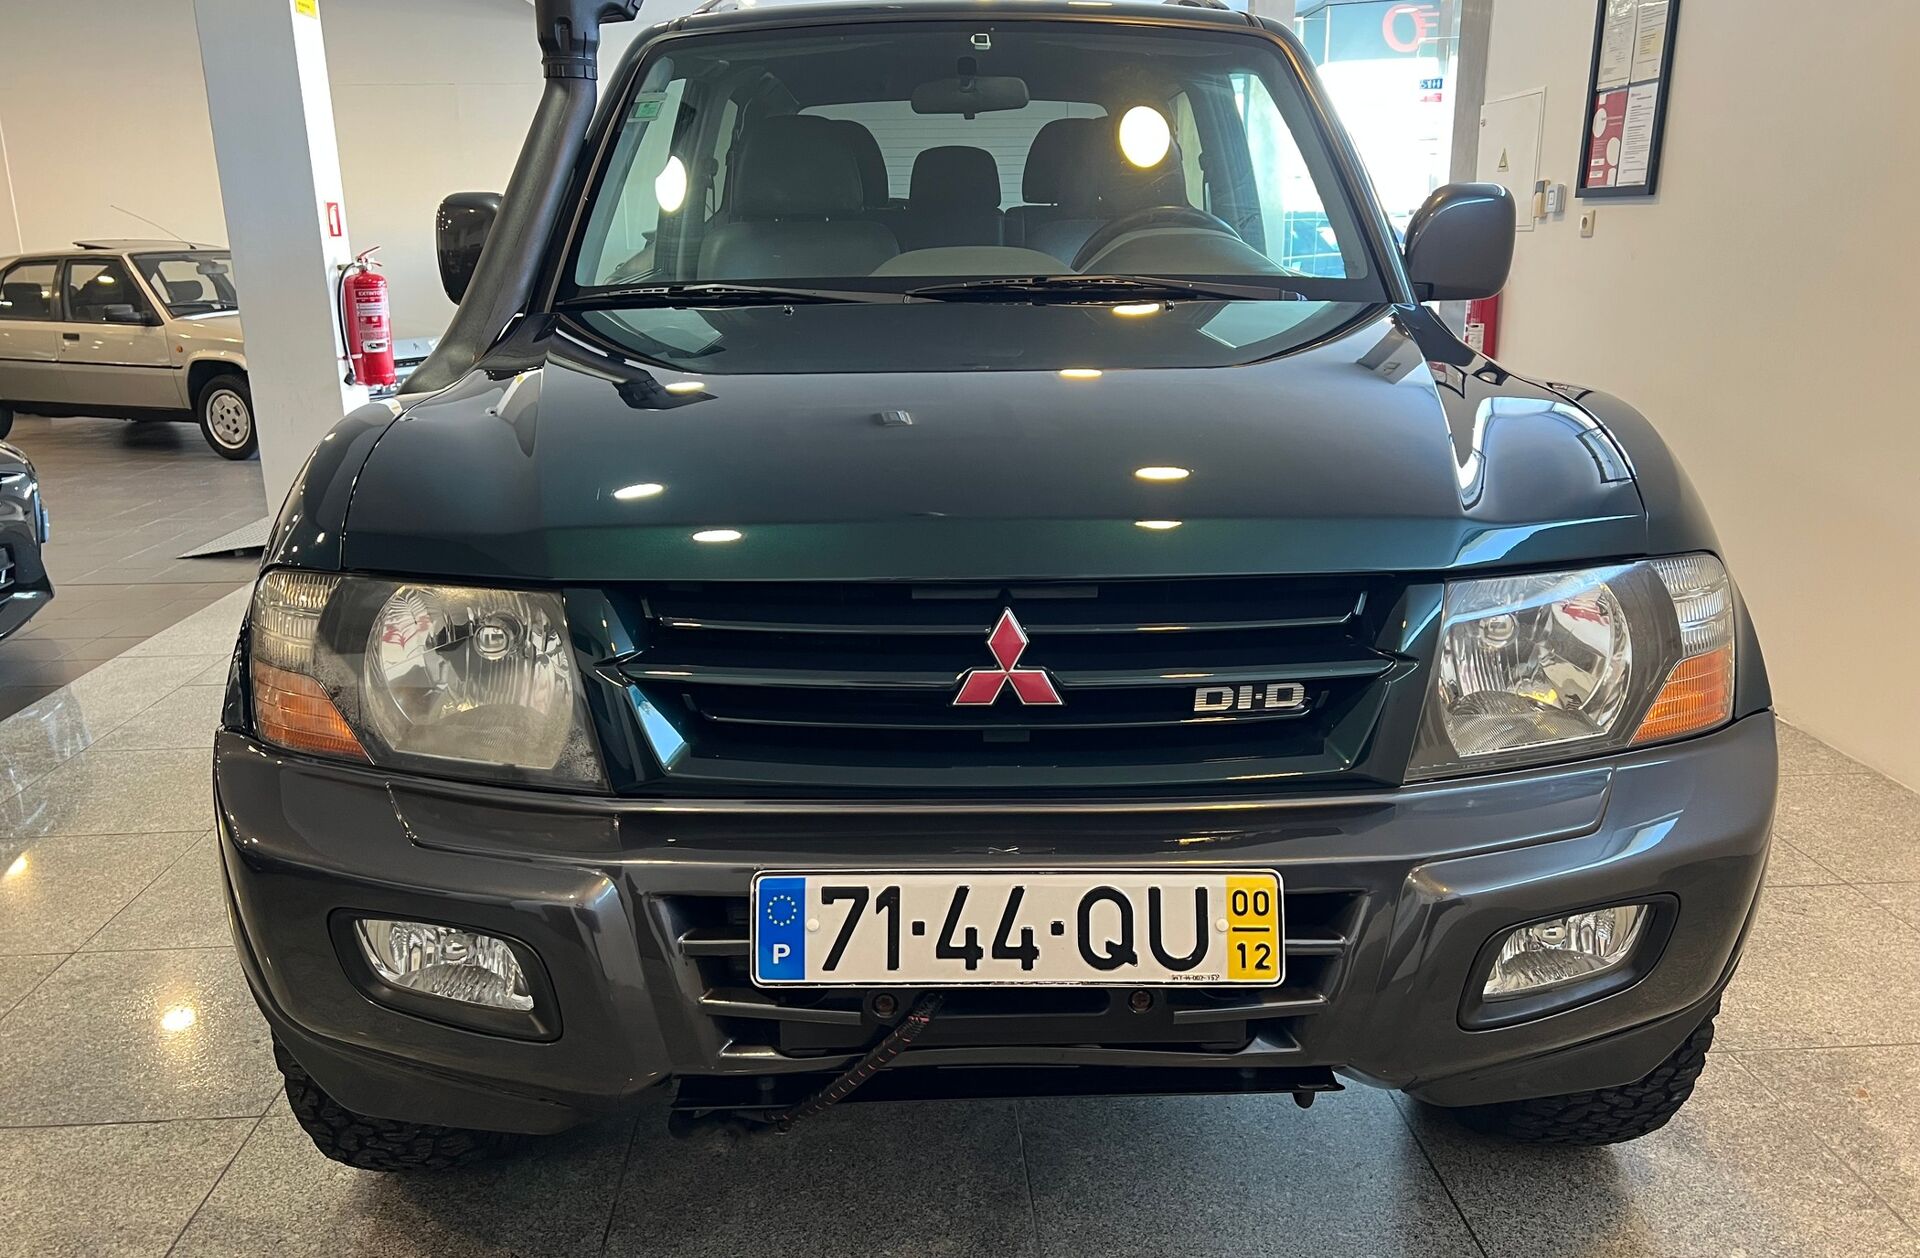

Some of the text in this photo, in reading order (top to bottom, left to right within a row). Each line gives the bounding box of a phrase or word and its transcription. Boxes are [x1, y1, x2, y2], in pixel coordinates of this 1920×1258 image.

[1193, 682, 1305, 712] DI-D
[1232, 889, 1270, 916] 00
[772, 943, 791, 965] P
[1236, 942, 1271, 970] 12
